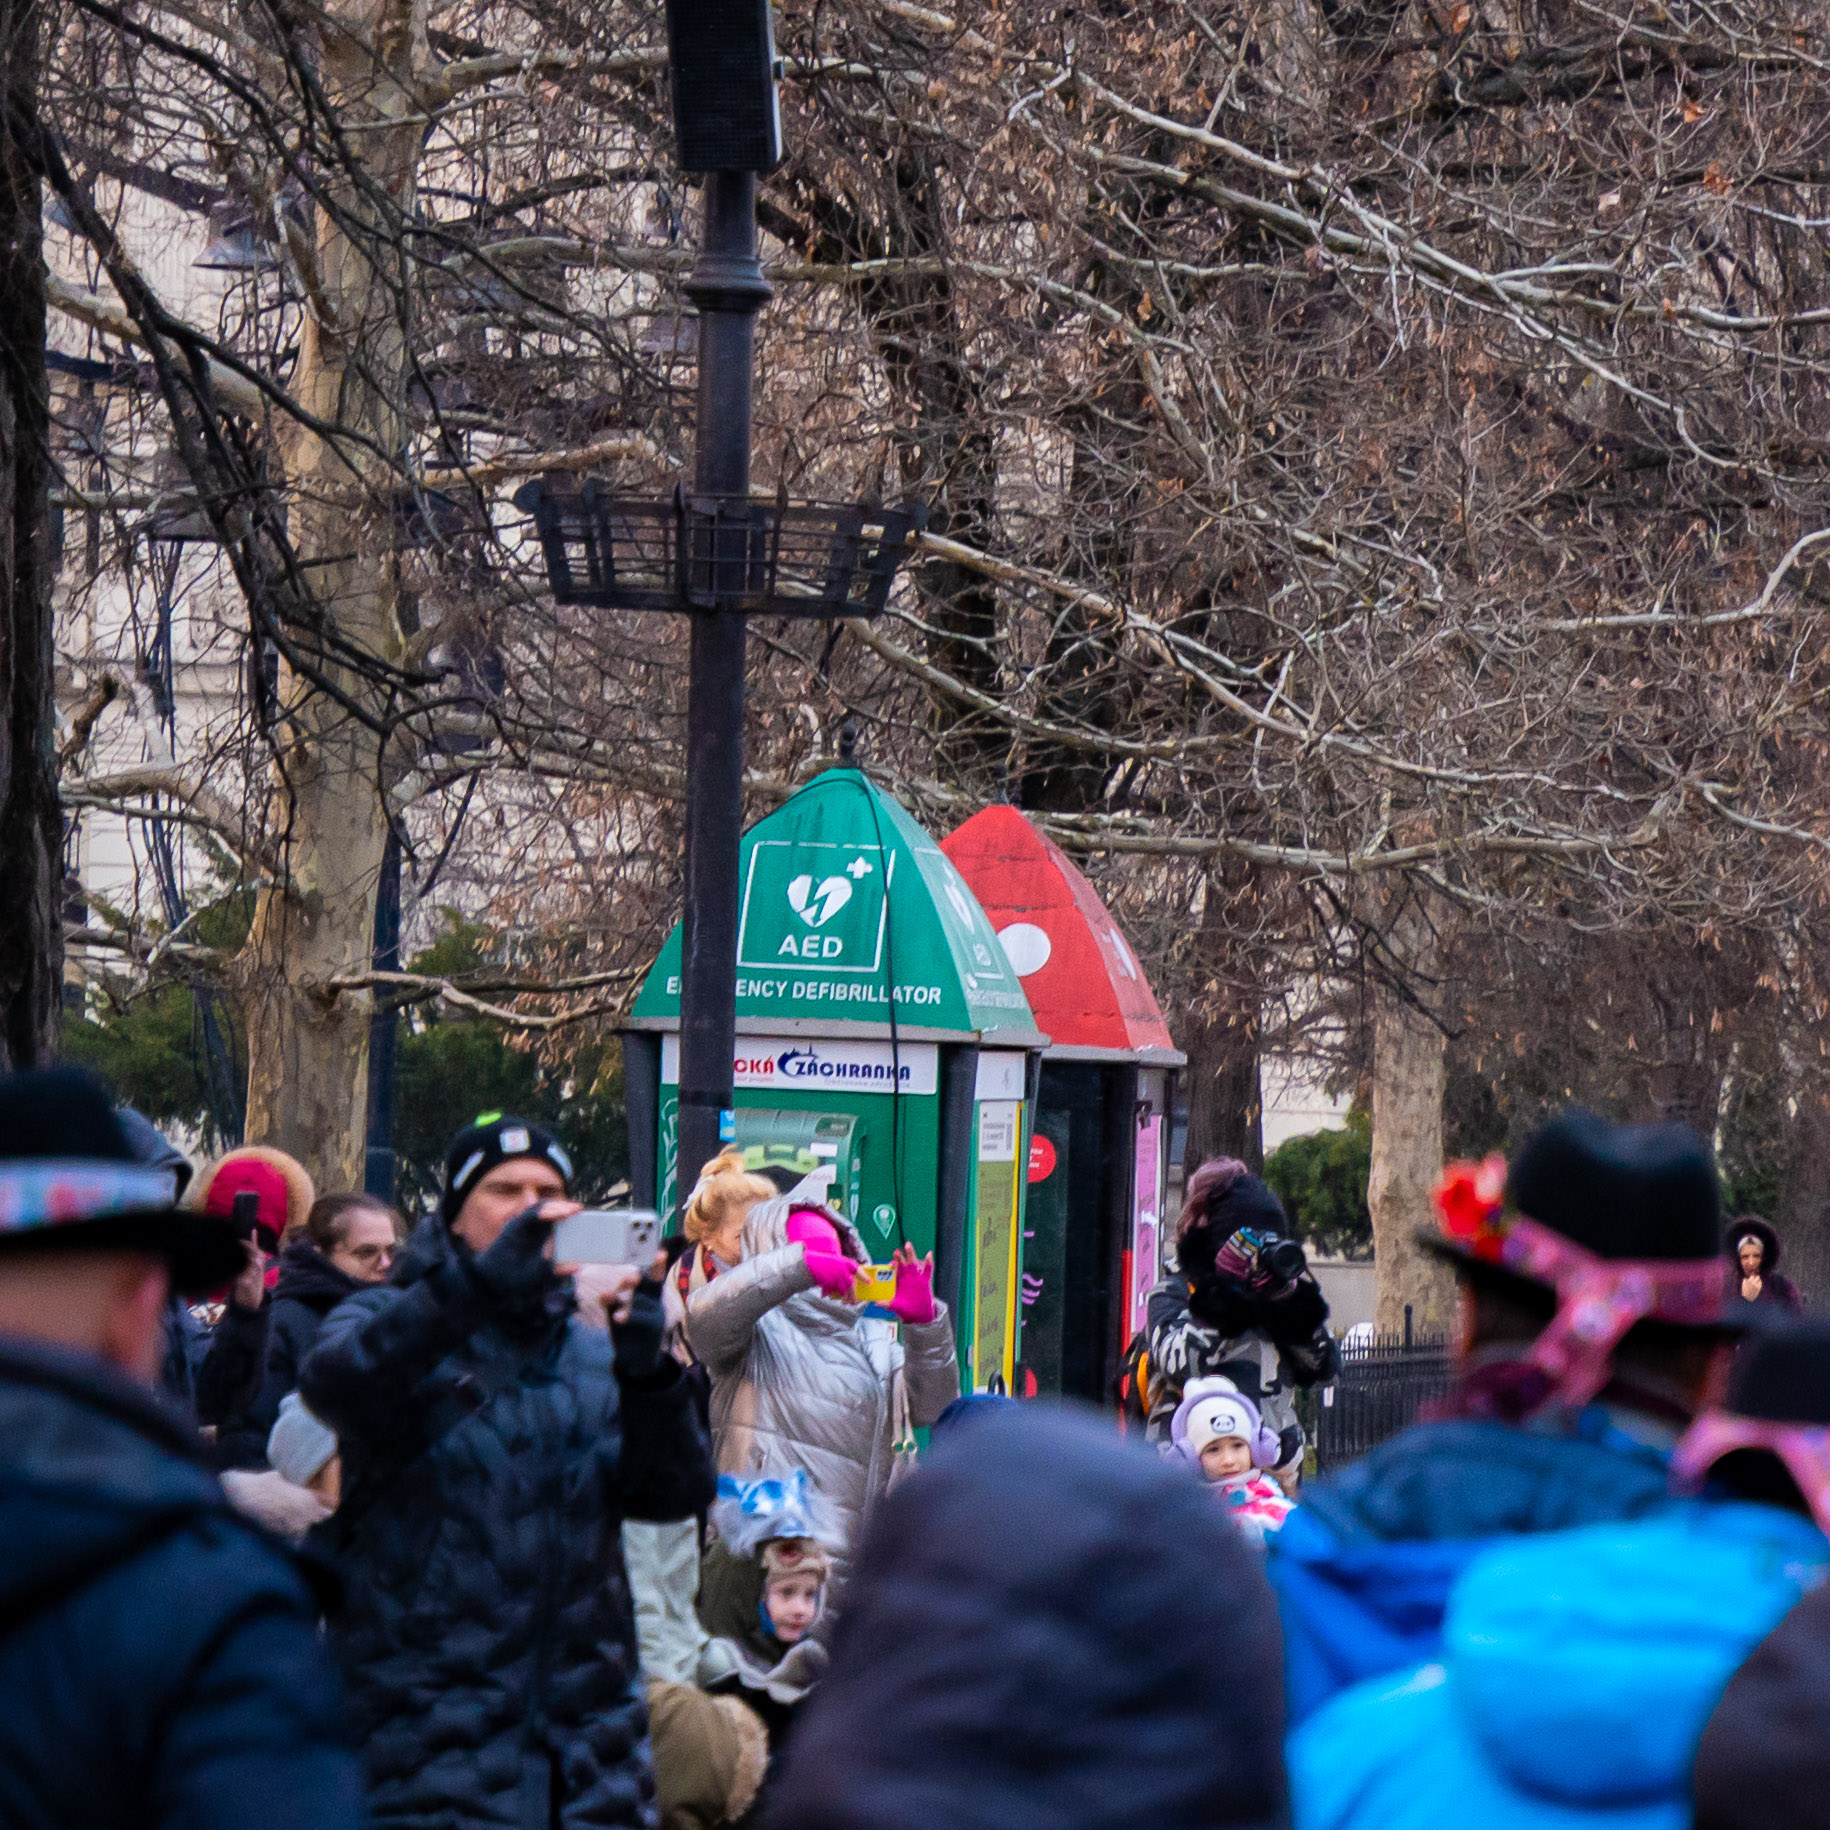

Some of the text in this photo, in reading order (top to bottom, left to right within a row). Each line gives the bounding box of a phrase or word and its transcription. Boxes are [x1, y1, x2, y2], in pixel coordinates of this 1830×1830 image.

[777, 934, 844, 958] AED
[666, 975, 788, 999] EENCY
[791, 981, 942, 1005] DEFIBRILLATOR
[795, 1058, 912, 1081] ZÁCHRANKA
